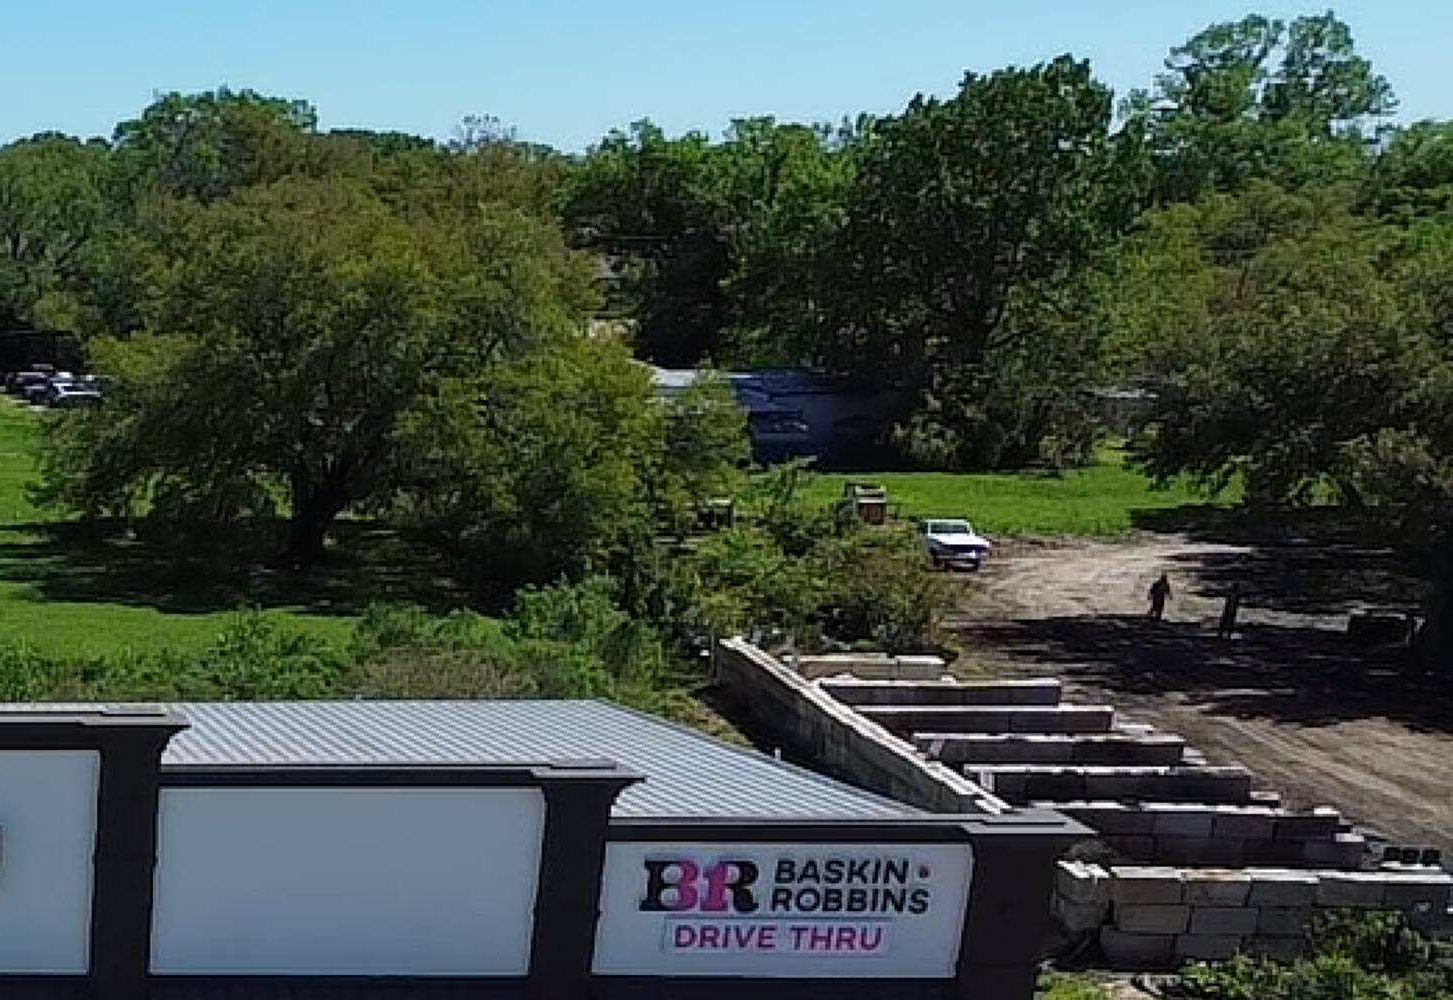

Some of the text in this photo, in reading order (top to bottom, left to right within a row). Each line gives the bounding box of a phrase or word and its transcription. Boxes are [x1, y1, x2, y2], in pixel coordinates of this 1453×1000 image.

[770, 887, 930, 914] ROBBINS
[674, 924, 883, 951] DRIVE THRU
